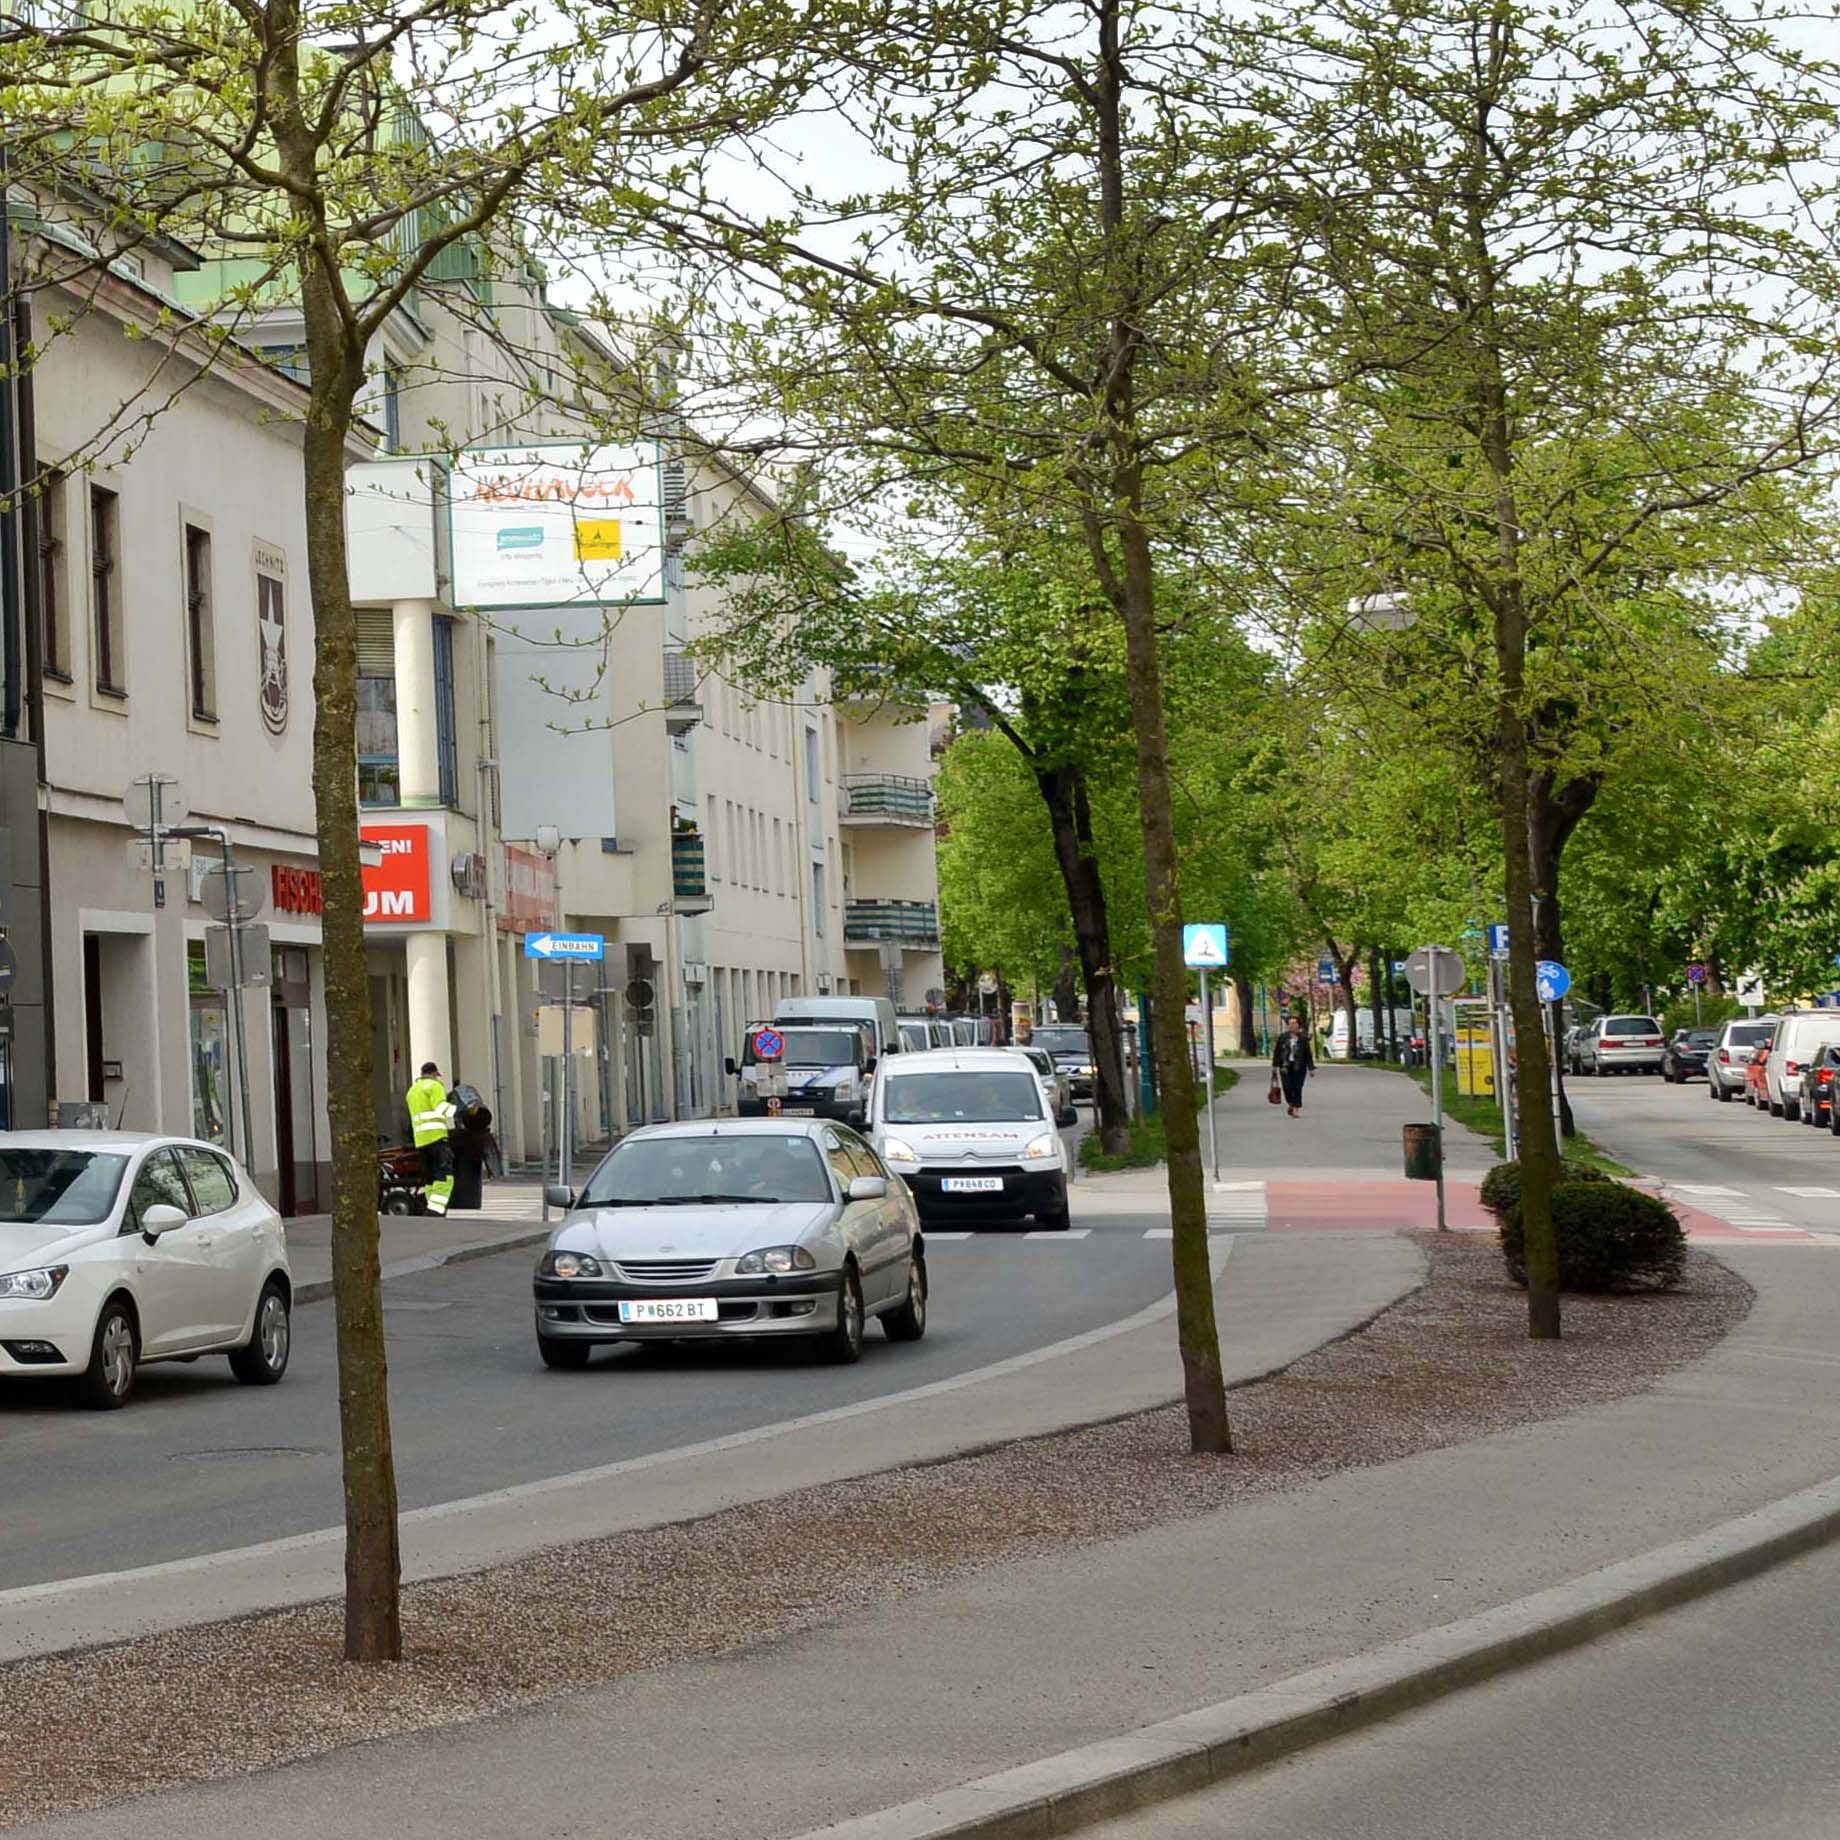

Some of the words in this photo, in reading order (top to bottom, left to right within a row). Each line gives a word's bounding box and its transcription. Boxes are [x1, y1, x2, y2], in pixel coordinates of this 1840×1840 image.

[379, 839, 412, 855] EN!
[272, 865, 323, 916] FISCH
[551, 940, 596, 951] EINBAHN
[923, 1131, 1019, 1140] ATTENSAM
[636, 1304, 645, 1318] P
[656, 1303, 684, 1317] 662
[687, 1303, 704, 1316] BT
